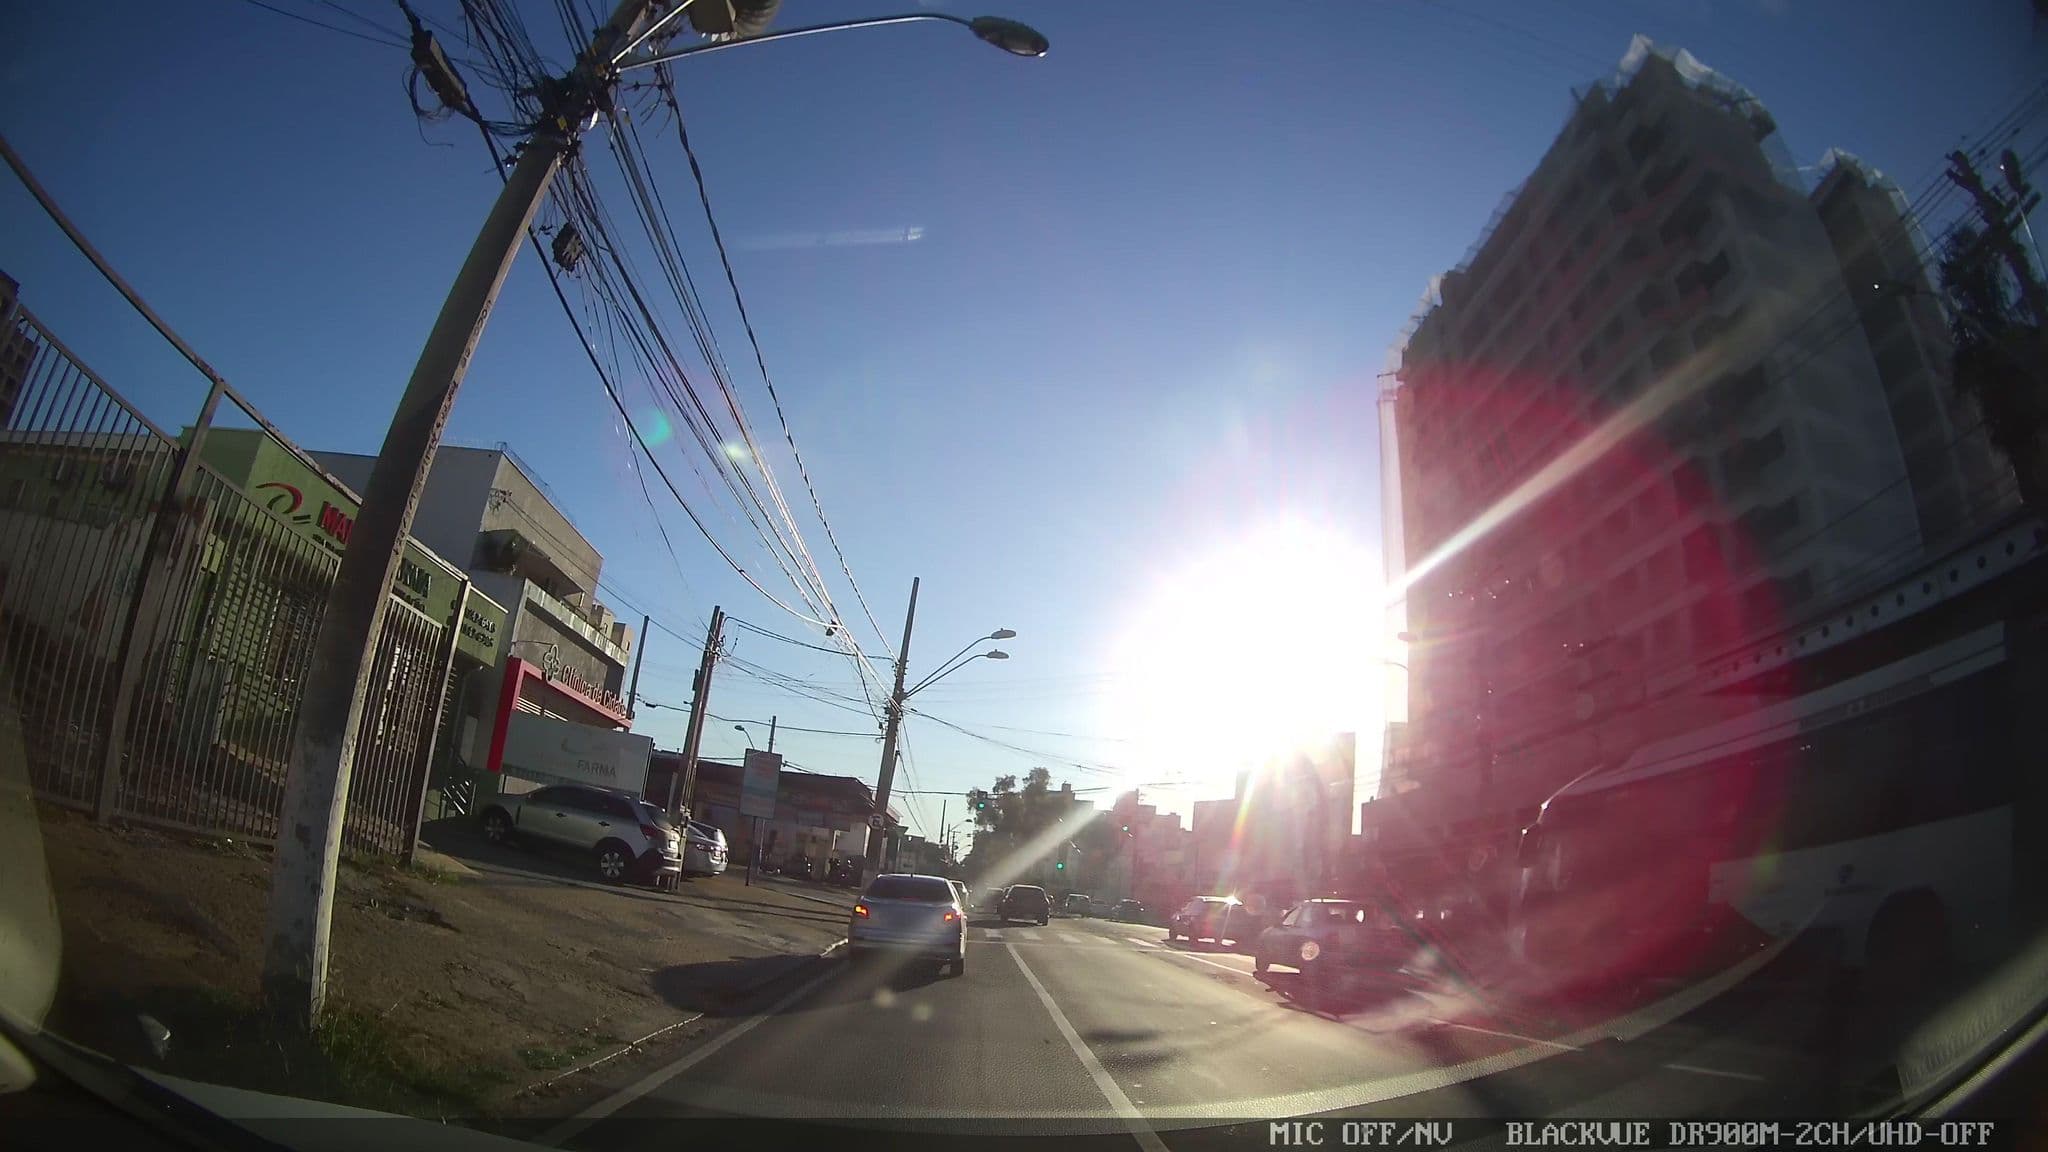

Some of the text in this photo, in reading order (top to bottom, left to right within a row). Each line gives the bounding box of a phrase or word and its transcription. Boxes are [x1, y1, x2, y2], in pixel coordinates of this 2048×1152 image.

[561, 664, 592, 698] Clínica
[591, 682, 603, 705] da
[577, 759, 617, 778] FARMA
